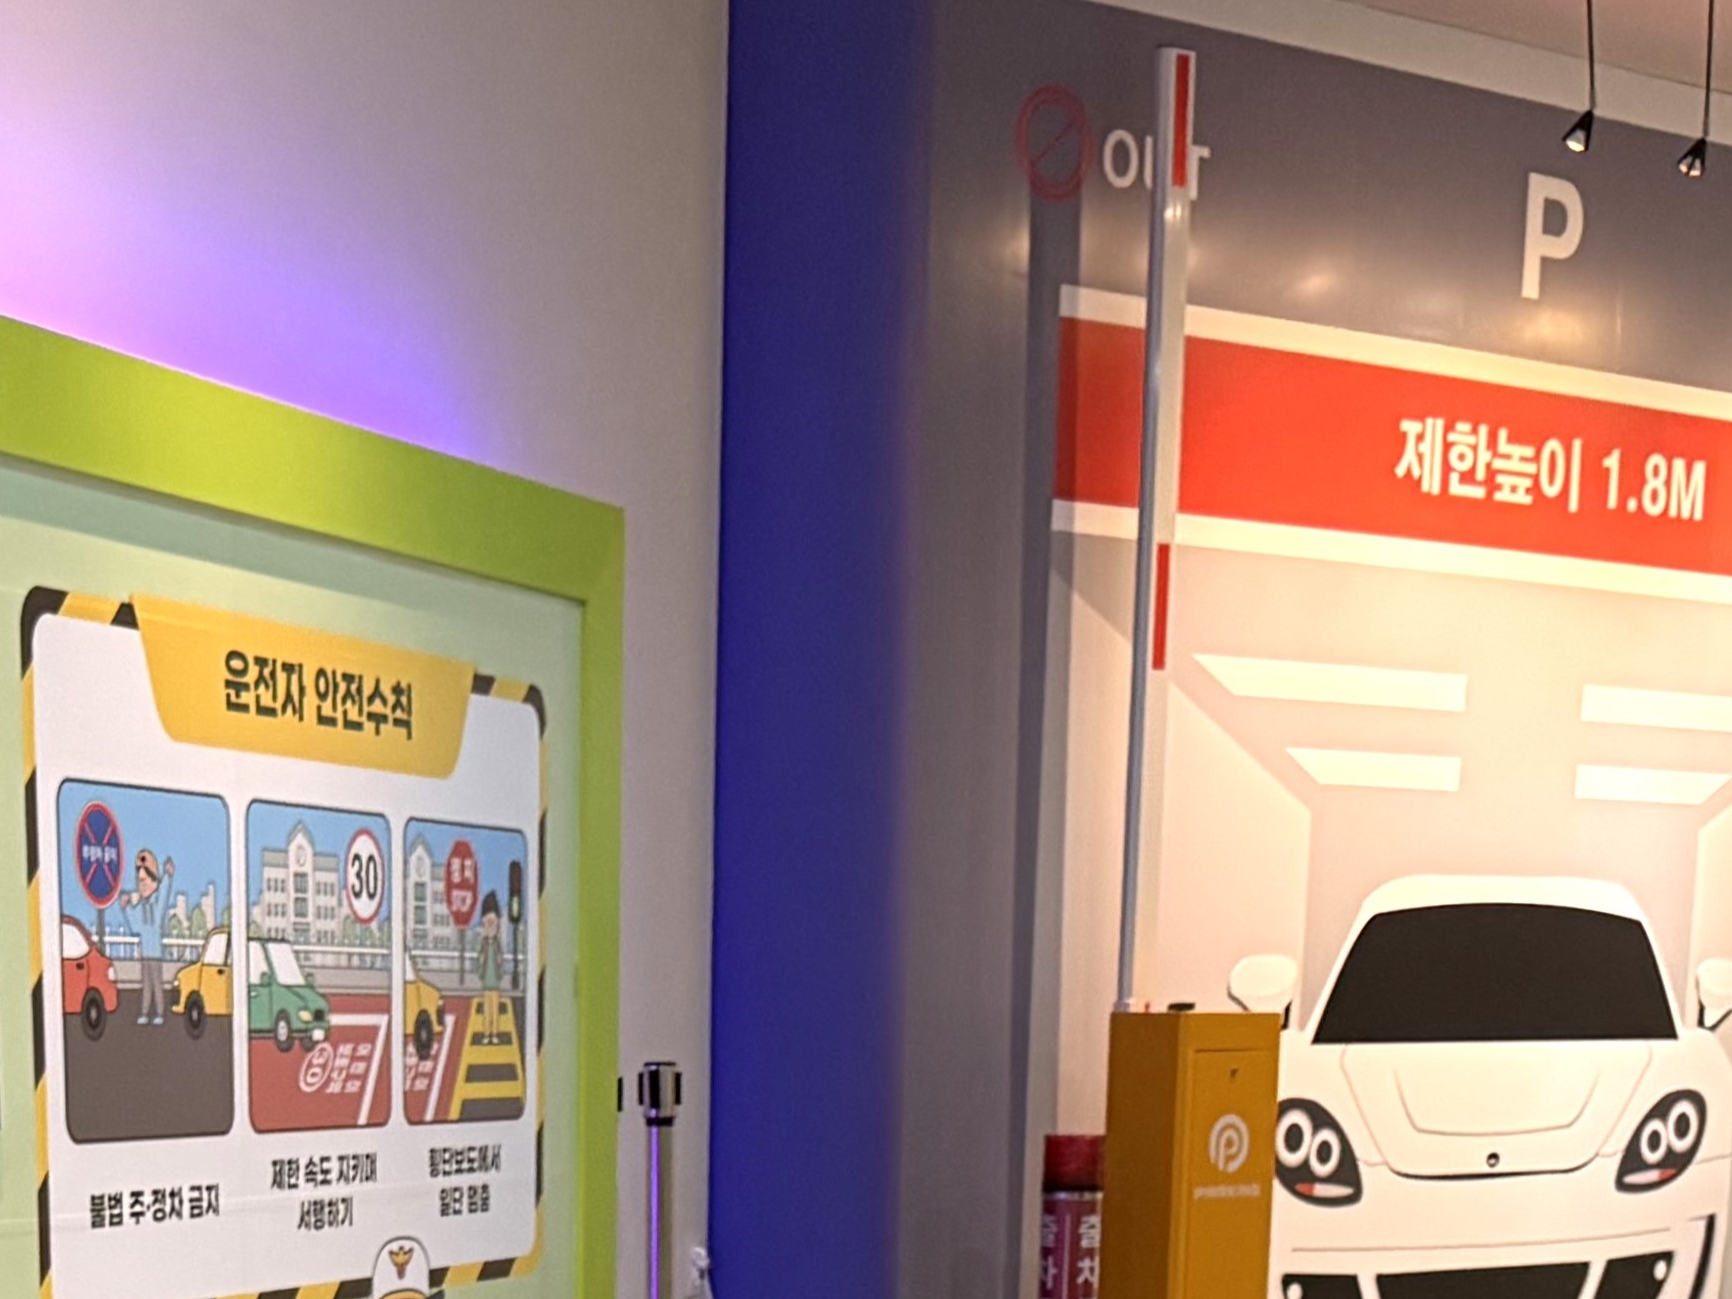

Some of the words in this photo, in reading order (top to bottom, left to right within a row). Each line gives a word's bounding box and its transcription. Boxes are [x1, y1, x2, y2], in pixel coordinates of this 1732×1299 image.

[1520, 171, 1585, 300] P
[1395, 415, 1582, 514] 제한높이
[1602, 448, 1707, 523] 1.8M
[223, 649, 306, 723] 운전자
[314, 666, 413, 741] 안전수칙
[351, 851, 378, 901] 30
[271, 1157, 300, 1191] 제한
[304, 1155, 332, 1188] 속도
[429, 1144, 503, 1178] 횡단보도에서
[89, 1190, 123, 1230] 불법
[189, 1182, 220, 1219] 금지
[297, 1196, 353, 1232] 서행하기
[439, 1186, 464, 1217] 일단
